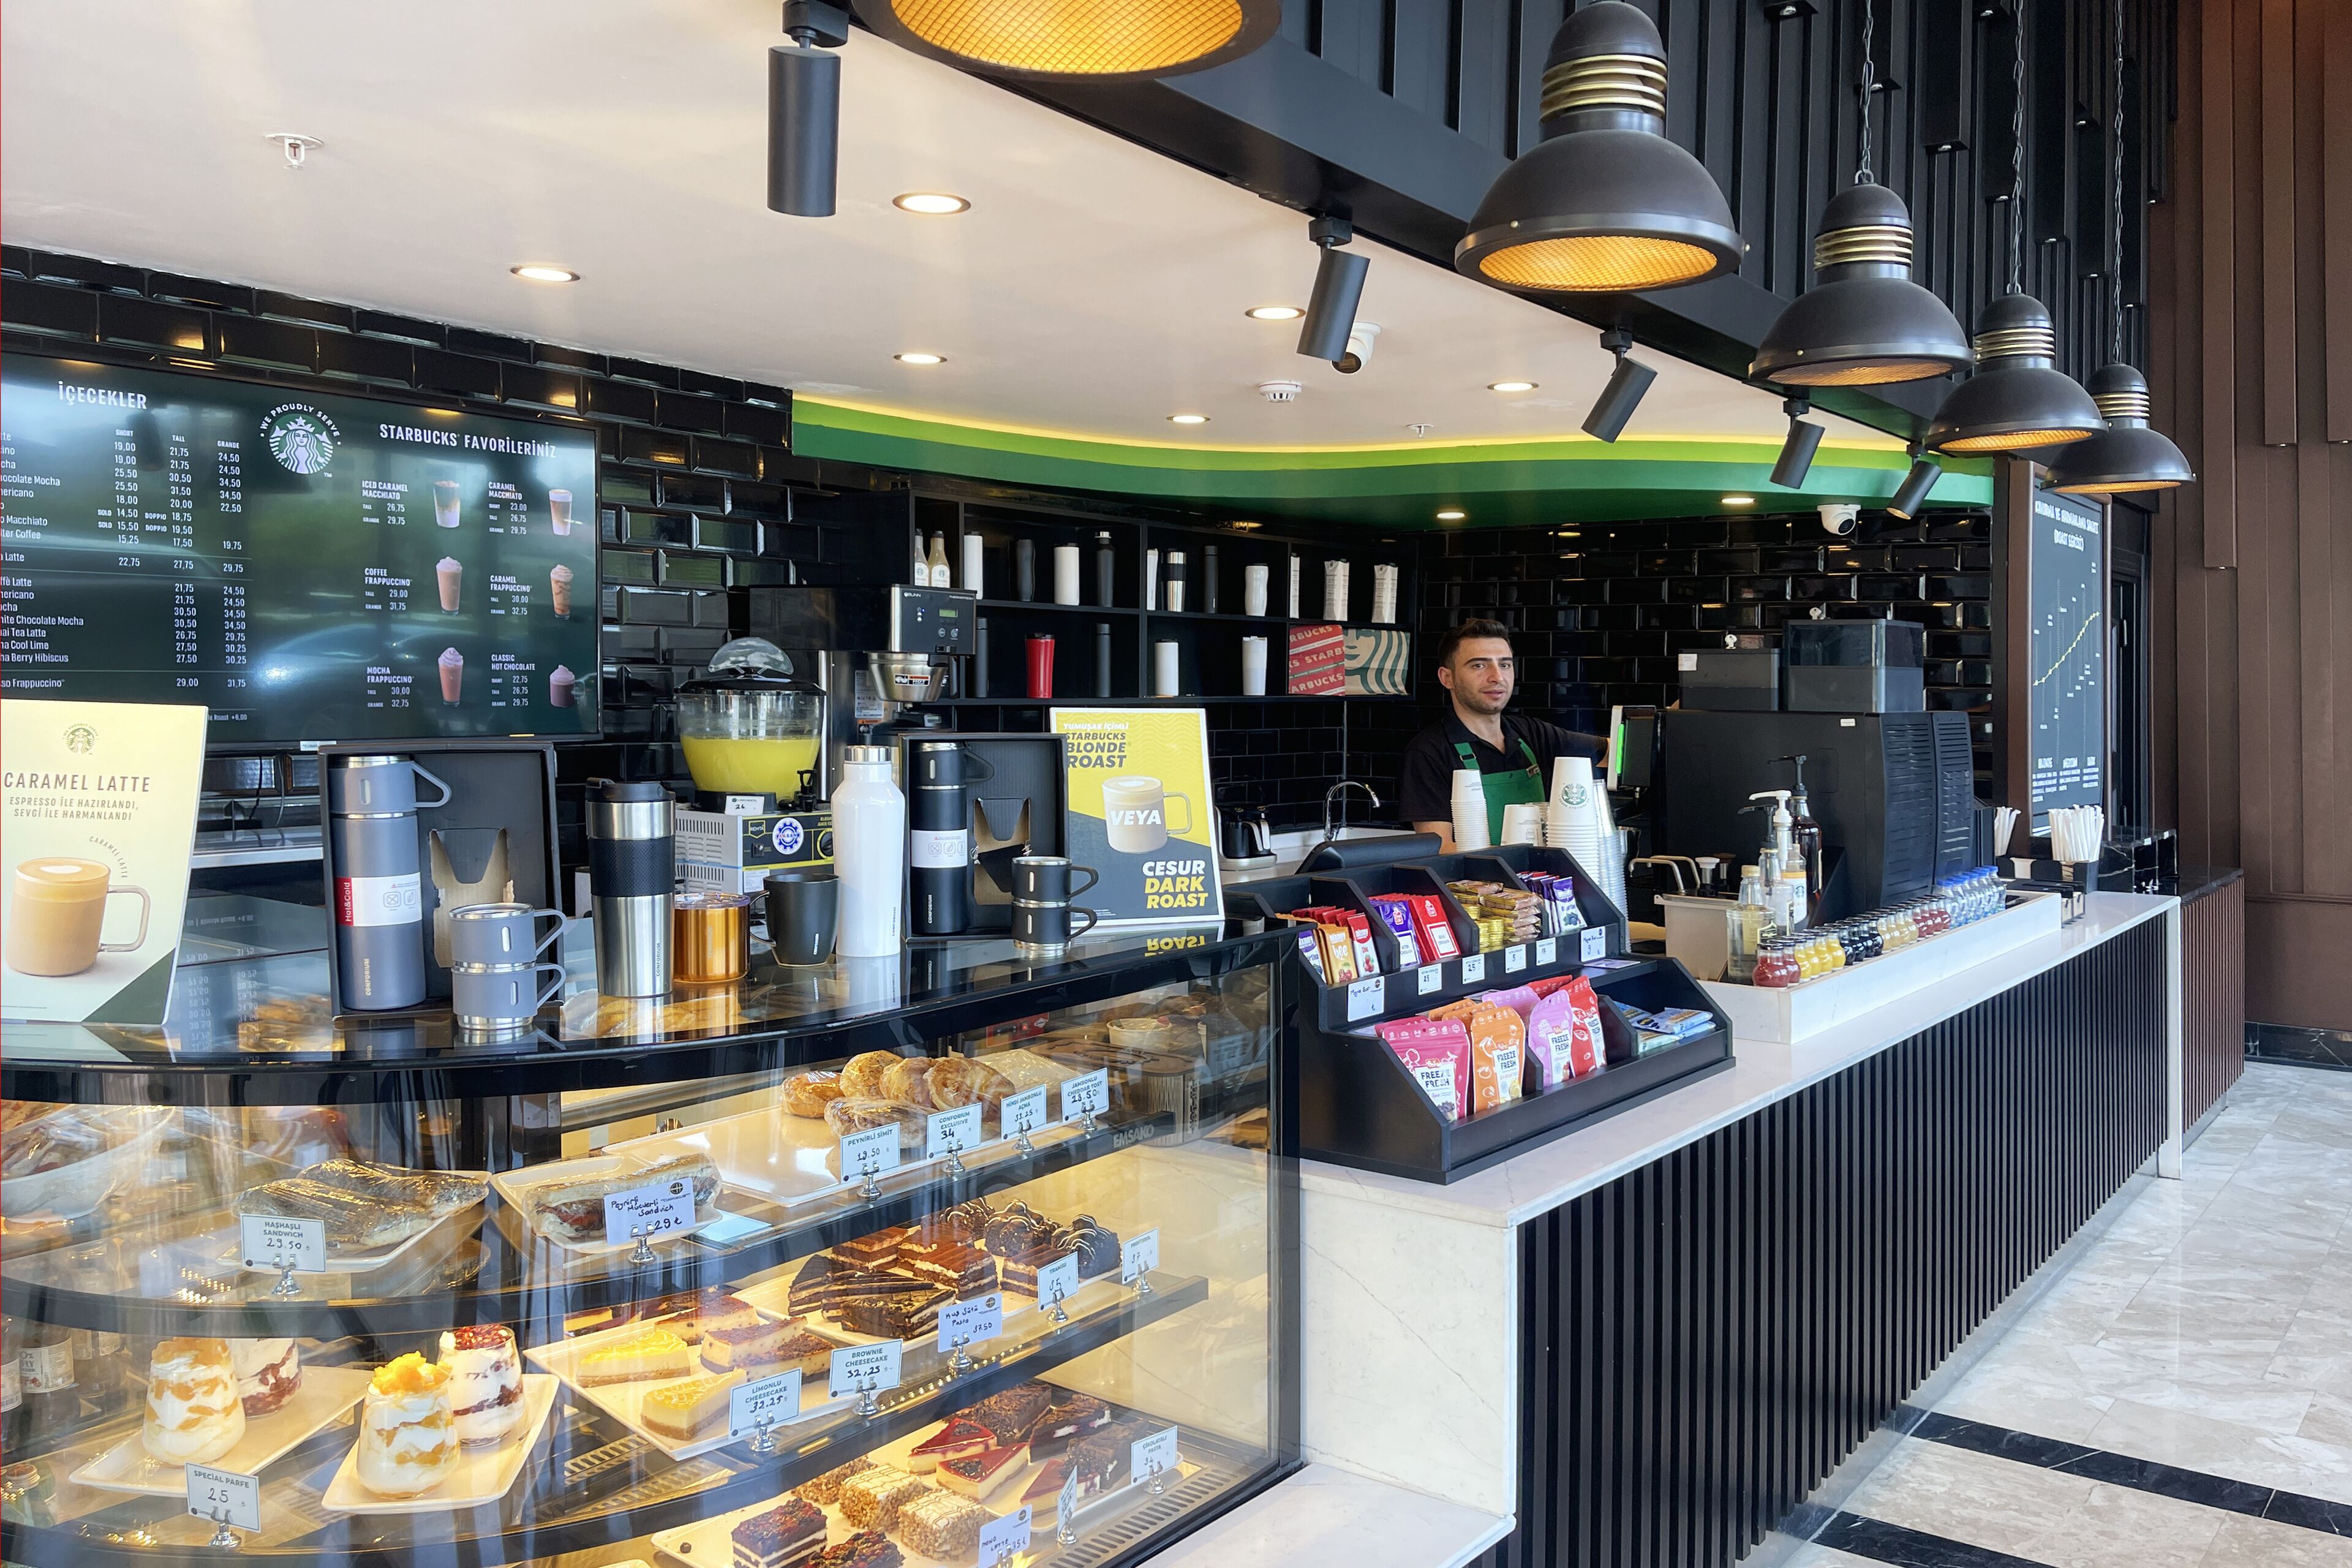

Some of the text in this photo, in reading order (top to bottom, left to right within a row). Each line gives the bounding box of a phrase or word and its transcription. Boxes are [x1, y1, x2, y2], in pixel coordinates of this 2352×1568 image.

[58, 380, 147, 410] İÇECEKLER
[260, 403, 341, 437] WE PROUDLY SERVE
[379, 423, 557, 459] STARBUCKS FAVORİLERİNİZ
[115, 442, 239, 462] 19,00 21,75 24,50
[34, 475, 60, 486] Mocha
[362, 480, 409, 492] ICED CARAMEL
[489, 481, 516, 491] CARAMEL
[362, 489, 401, 500] MACCHIATO
[489, 490, 522, 500] MACCHIATO
[387, 503, 405, 512] 26,75
[510, 502, 527, 511] 23,00
[7, 515, 48, 526] Macchiato
[387, 516, 405, 526] 29,75
[511, 513, 527, 522] 26,75
[511, 526, 527, 535] 29,75
[16, 529, 242, 550] Coffee 15,25 17,50 19,75
[5, 552, 243, 573] Latte 22,75 27,75 29,75
[364, 568, 387, 576] COFFEE
[491, 575, 516, 584] CARAMEL
[12, 577, 244, 595] Latte 21,75 24,50
[389, 589, 408, 598] 29,00
[390, 602, 406, 611] 31,75
[511, 607, 527, 616] 32,75
[17, 615, 246, 630] Chocolate Mocha 30,50 34,50
[11, 628, 46, 637] Tea Latte
[11, 640, 49, 649] Cool Lime
[12, 653, 69, 663] Berry Hibiscus
[1305, 646, 1345, 664] STARB
[176, 678, 198, 687] 29,00
[227, 679, 246, 688] 31,75
[512, 675, 528, 684] 22,75
[391, 687, 410, 695] 30,00
[513, 686, 528, 695] 26,75
[513, 698, 529, 707] 29,75
[1063, 722, 1129, 731] YUMUŞAK İÇİMLİ
[1068, 742, 1126, 753] BLONDE
[1068, 755, 1127, 768] ROAST
[4, 772, 150, 793] CARAMEL LATTE
[9, 796, 139, 811] ESPRESSO İLE HAZIRLANDI,
[13, 807, 132, 821] SEVGİ İLE HARMANLANDI
[1109, 809, 1162, 826] VEYA
[89, 835, 128, 879] CARAMEL LATTE
[1142, 859, 1205, 876] CESUR
[1144, 876, 1205, 894] DARK
[1147, 892, 1208, 910] ROAST
[1332, 944, 1348, 960] bee
[1551, 1034, 1569, 1044] FREEZE
[1496, 1050, 1517, 1063] FREEZE
[1500, 1060, 1517, 1071] FRESH
[1420, 1069, 1451, 1080] FREEZE
[1072, 1076, 1098, 1088] JAMBONLU
[1425, 1079, 1450, 1088] FRESH
[1067, 1080, 1102, 1096] CHEDDAR TOST
[1019, 1090, 1042, 1102] JAMBONLU
[939, 1112, 970, 1123] CONFORIUM
[940, 1118, 968, 1129] EXCLUSIVE
[848, 1129, 893, 1146] PEYNİRLİ SİMİT
[941, 1128, 954, 1140] 34
[1113, 1124, 1155, 1149] EMSAKO
[265, 1221, 301, 1231] HAŞHAŞLI
[263, 1229, 303, 1238] SANDWICH
[266, 1238, 302, 1250] 29.50
[851, 1348, 883, 1359] BROWNIE
[845, 1355, 888, 1368] CHEESECAKE
[752, 1380, 782, 1393] LİMONLU
[745, 1385, 788, 1404] CHEESECAKE
[194, 1470, 250, 1488] SPECİAL PARFE
[208, 1487, 228, 1503] 25
